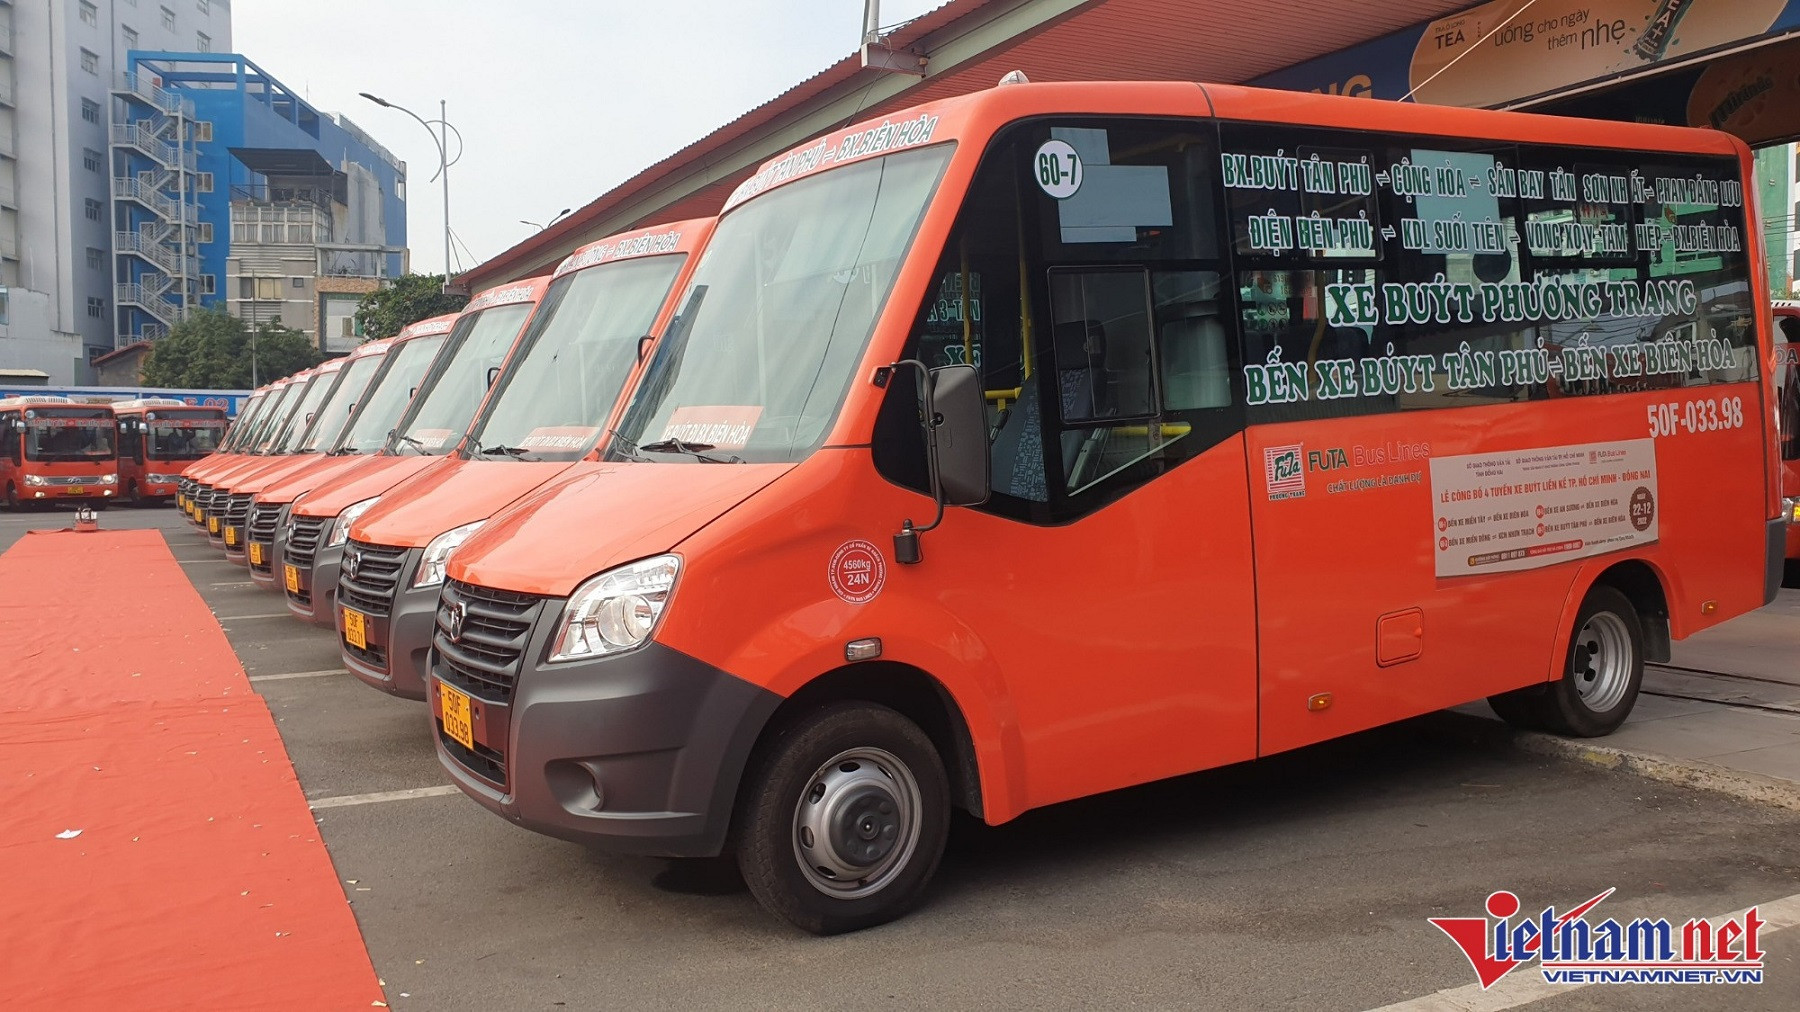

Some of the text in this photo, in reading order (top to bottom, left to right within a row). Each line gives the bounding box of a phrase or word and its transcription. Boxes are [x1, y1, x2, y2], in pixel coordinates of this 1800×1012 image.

[1494, 21, 1535, 47] uống
[1537, 9, 1590, 34] cho ngày
[1547, 18, 1626, 50] thêm nhẹ
[1434, 29, 1465, 50] TEA
[834, 121, 897, 163] BX.BIÊN
[895, 113, 938, 149] HÒA
[1039, 153, 1077, 186] 60-7
[1221, 149, 1298, 191] BX.BUÝT
[1300, 152, 1336, 195] TÂN
[1338, 155, 1372, 196] PHÚ
[1391, 156, 1433, 203] CỘNG
[1436, 159, 1467, 198] HÒA
[1487, 161, 1517, 198] SÂN
[1518, 169, 1544, 200] BAY
[1549, 165, 1577, 202] TÂN
[1582, 173, 1610, 204] SƠN
[1655, 177, 1688, 205] PHAN
[1719, 179, 1742, 208] LƯU
[1248, 208, 1294, 257] ĐIỆN
[1337, 209, 1373, 251] PHỦ
[1401, 217, 1431, 250] KDL
[1433, 211, 1469, 251] SUỐI
[1471, 216, 1506, 252] TIÊN
[1525, 215, 1562, 251] VÒNG
[1635, 218, 1662, 257] HIỆP
[1672, 220, 1718, 251] BX.BIÊN
[1716, 219, 1741, 252] HÒA
[1328, 282, 1379, 328] XE
[1382, 272, 1475, 326] BUÝT
[1480, 274, 1602, 323] PHƯƠNG
[1606, 279, 1697, 318] TRANG
[1244, 345, 1309, 406] BẾN
[1314, 358, 1359, 400] XE
[1443, 341, 1496, 390] TÂN
[1562, 332, 1609, 382] BẾN
[1612, 343, 1643, 378] XE
[1643, 330, 1692, 376] BIÊN
[1695, 328, 1737, 372] HÒA
[1647, 396, 1744, 438] 50F-033.98
[1307, 440, 1431, 473] FUTA Bus Lines
[1327, 480, 1348, 494] CHẤT
[1377, 474, 1388, 487] LÀ
[1451, 487, 1472, 501] CÔNG
[1473, 485, 1483, 500] BỐ
[1484, 489, 1489, 498] 4
[1490, 483, 1513, 498] TUYẾN
[1514, 484, 1523, 495] XE
[1524, 481, 1542, 493] BUÝT
[1578, 474, 1587, 487] HỒ
[1588, 474, 1600, 486] CHÍ
[1600, 473, 1617, 485] MINH
[1622, 468, 1639, 482] ĐỒNG
[1639, 470, 1651, 479] NAI
[1632, 502, 1652, 516] 22-12
[843, 559, 871, 571] 4560kg
[847, 573, 869, 586] 24N
[447, 690, 461, 715] 50F
[445, 710, 470, 745] 033.98
